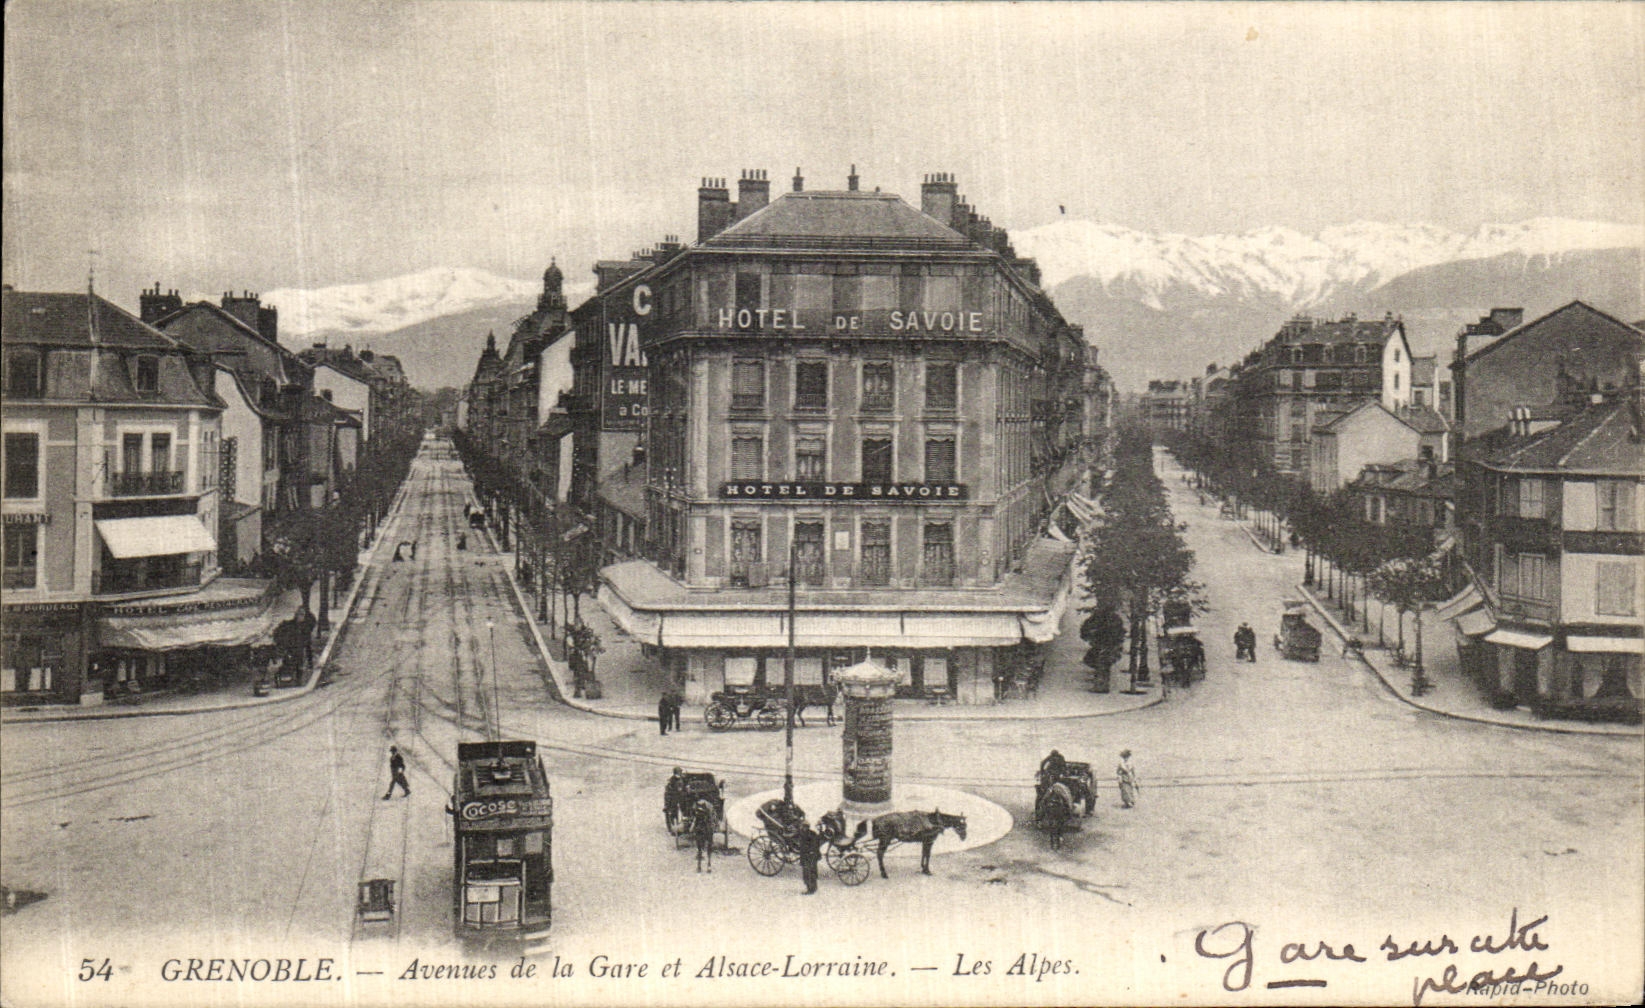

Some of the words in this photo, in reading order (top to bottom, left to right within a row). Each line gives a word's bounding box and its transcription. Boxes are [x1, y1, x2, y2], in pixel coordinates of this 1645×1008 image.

[718, 309, 806, 329] HOTEL
[835, 316, 859, 330] DE
[889, 311, 983, 331] SAVOIE
[608, 323, 649, 367] VA
[610, 379, 625, 395] LE
[727, 485, 807, 495] HOTEL
[825, 486, 854, 496] DE
[871, 486, 960, 497] SAVOIE
